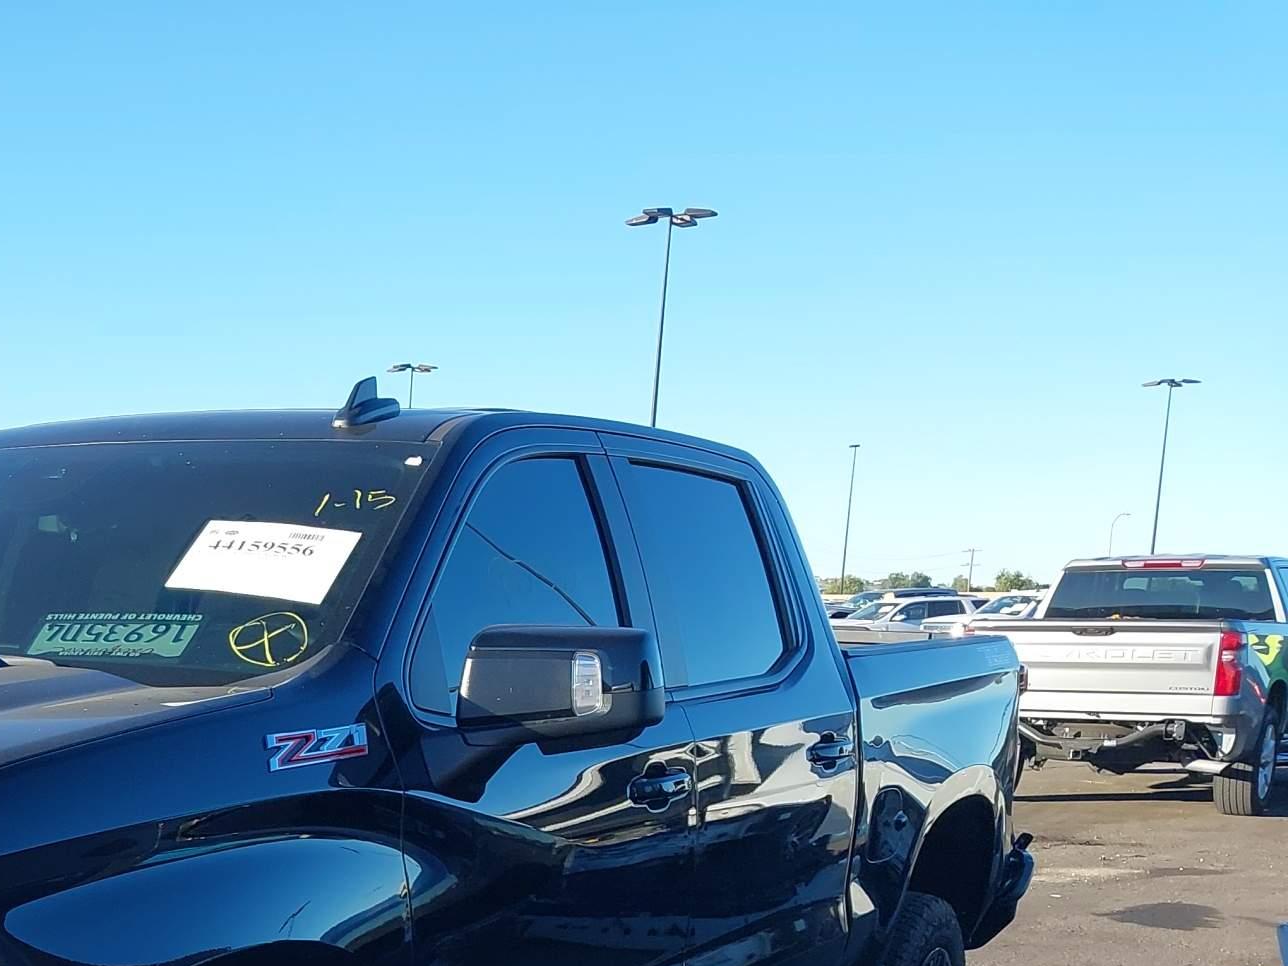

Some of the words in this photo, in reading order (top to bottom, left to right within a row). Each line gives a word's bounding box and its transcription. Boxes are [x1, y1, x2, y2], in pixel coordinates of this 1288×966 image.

[314, 489, 396, 517] 1-15
[208, 539, 315, 557] 44159556
[78, 613, 122, 621] PUENTE
[122, 613, 137, 621] OF
[138, 614, 203, 622] CHEVROLET
[265, 722, 369, 772] Z71
